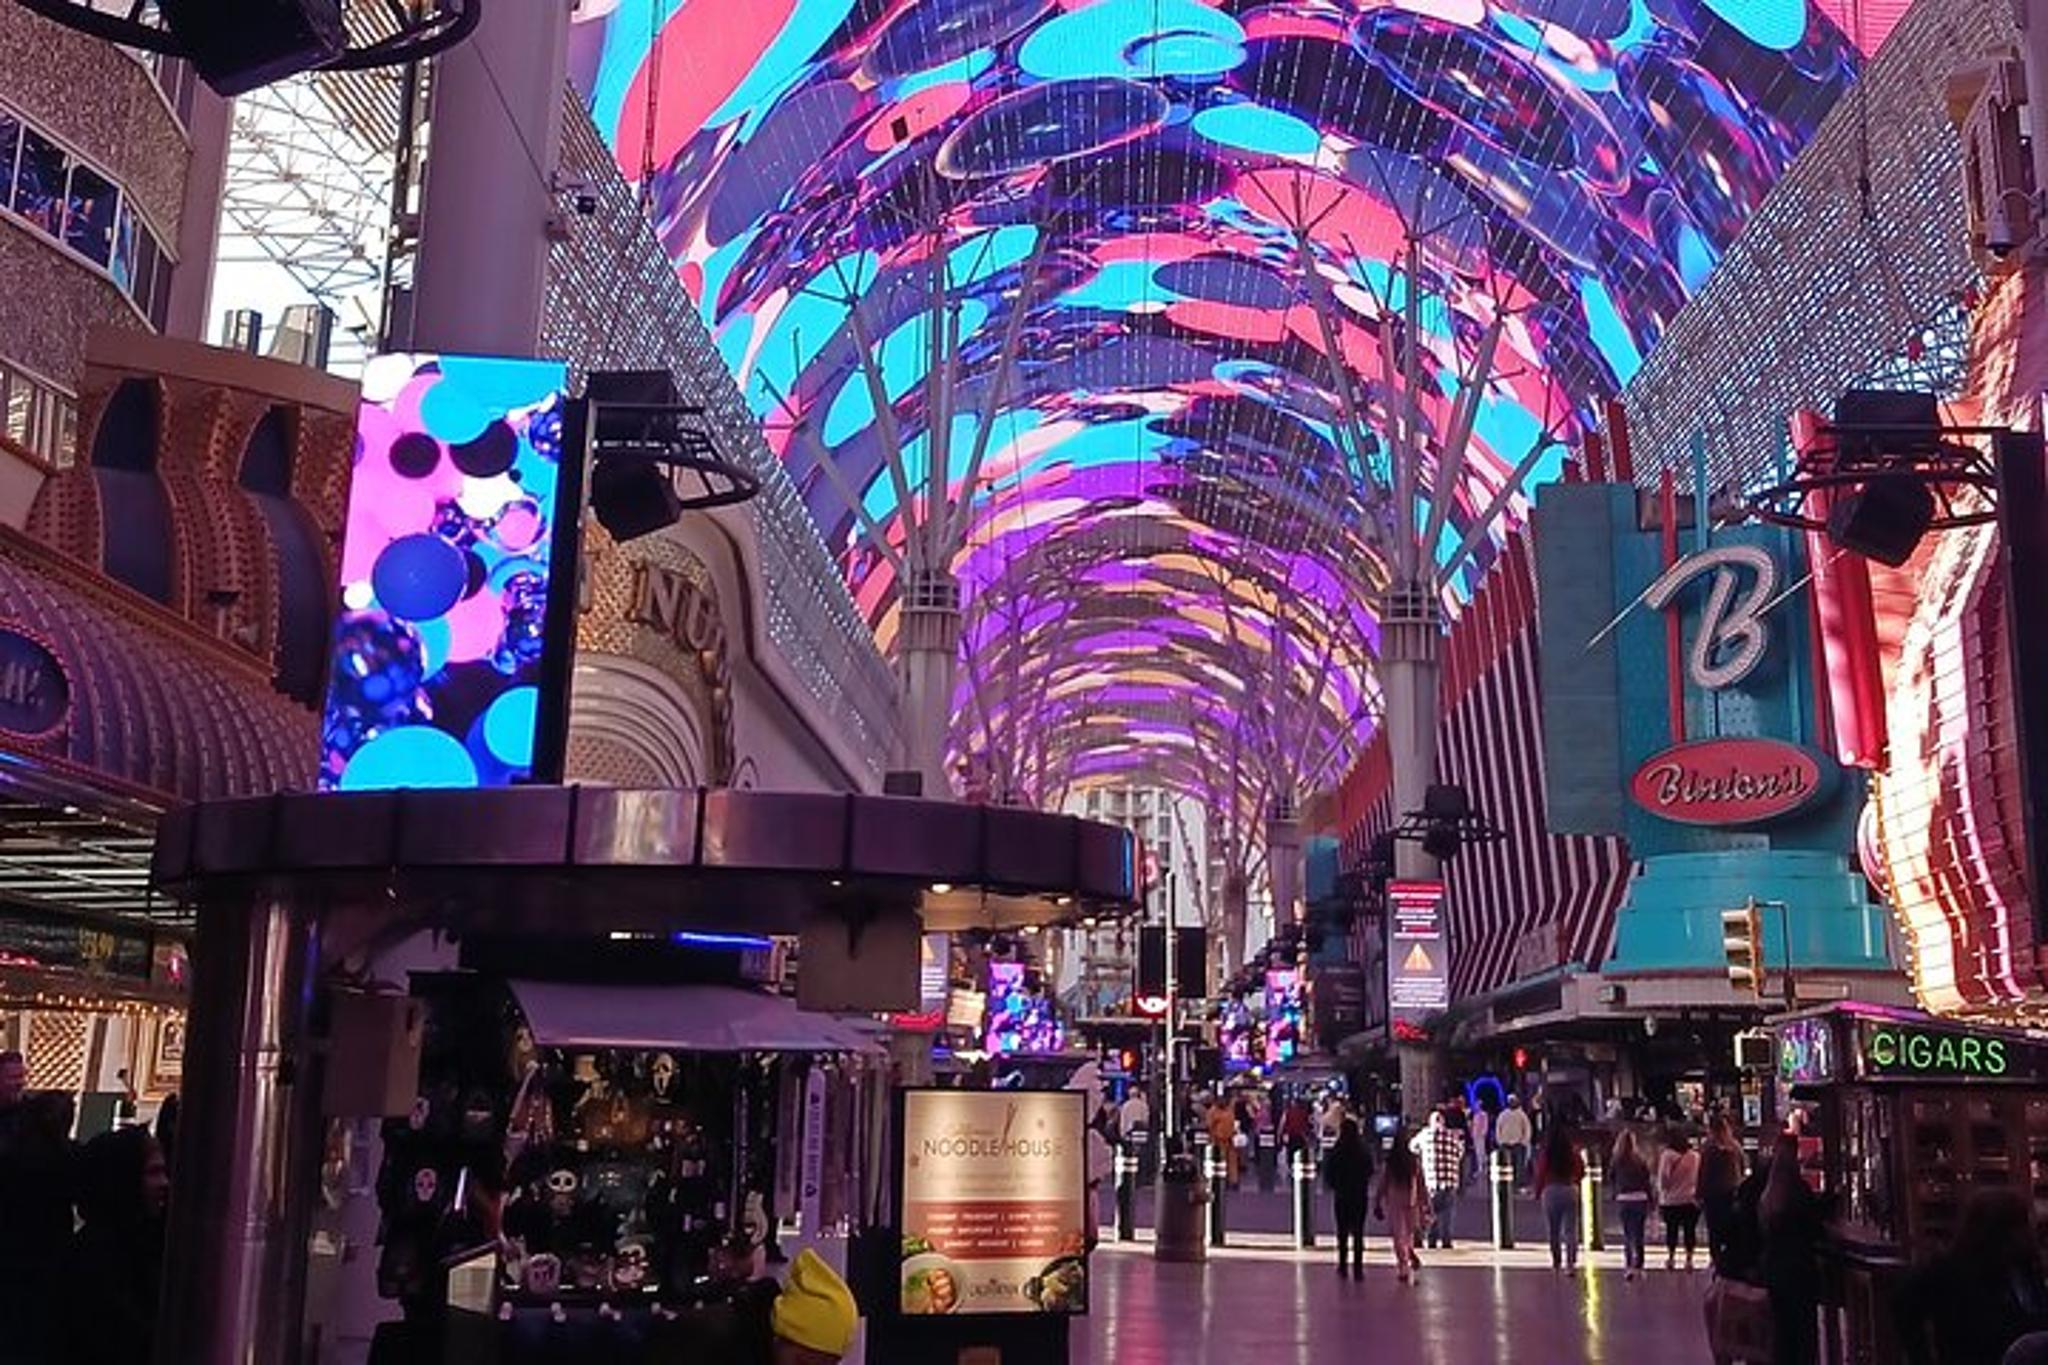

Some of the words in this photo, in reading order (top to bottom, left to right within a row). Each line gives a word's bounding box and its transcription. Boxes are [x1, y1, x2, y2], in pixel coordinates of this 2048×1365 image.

[1646, 763, 1808, 806] Binion's
[1873, 1031, 2007, 1075] CIGARS
[923, 1138, 1000, 1157] NOODLE
